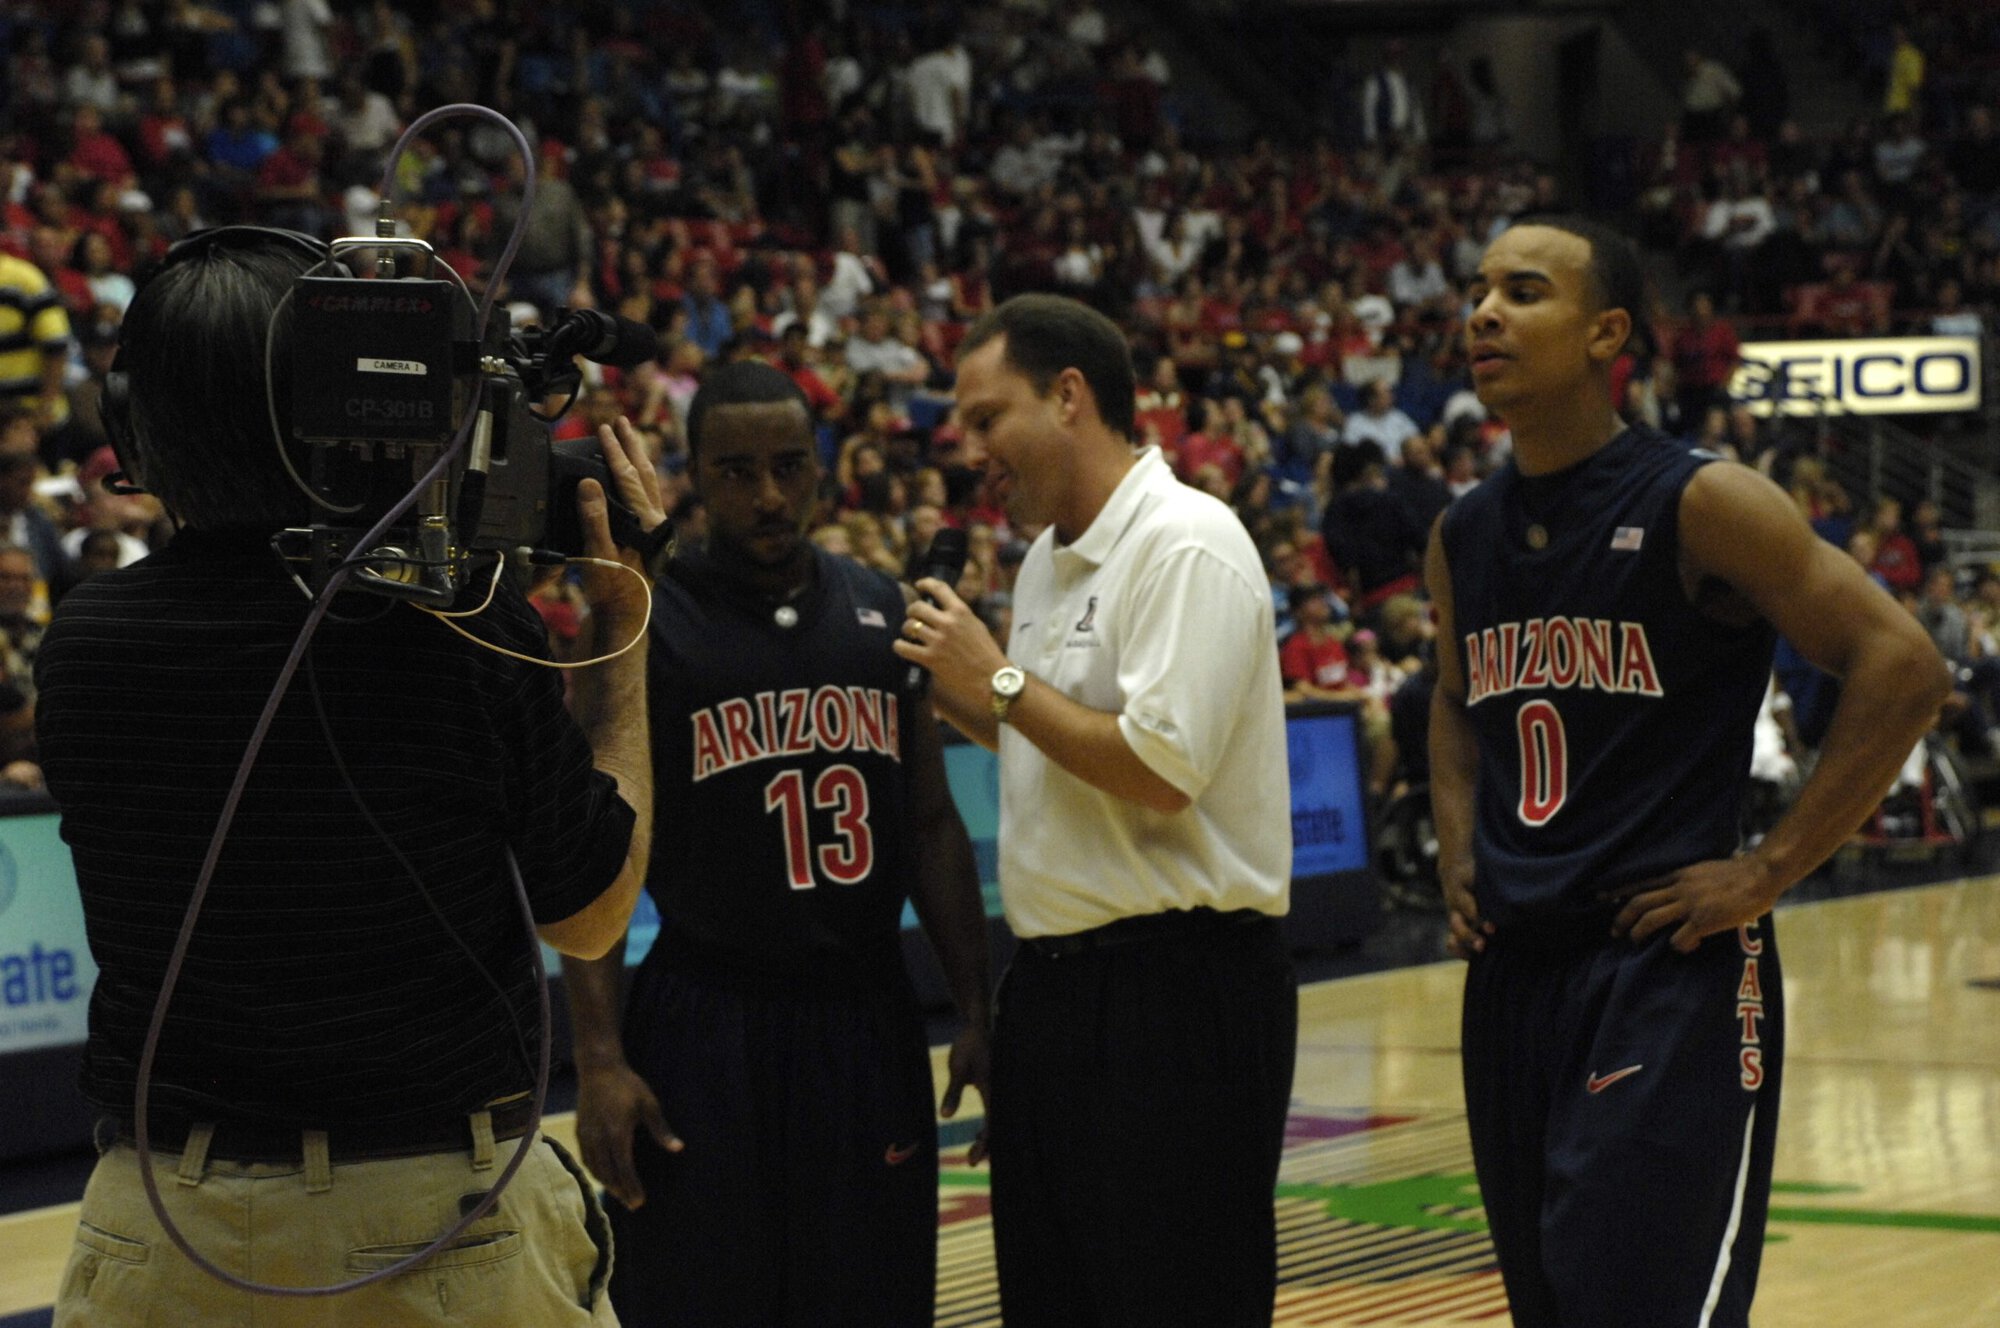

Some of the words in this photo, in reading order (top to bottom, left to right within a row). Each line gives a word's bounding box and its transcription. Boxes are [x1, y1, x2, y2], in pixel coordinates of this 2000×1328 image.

[322, 295, 419, 313] CAMPLEX
[374, 361, 410, 370] CAMERA
[345, 398, 434, 419] CP-301B
[1465, 615, 1665, 708] ARIZONA
[1516, 699, 1568, 828] 0
[764, 763, 874, 891] 13
[0, 942, 77, 1006] ate
[1735, 921, 1766, 1091] CATS
